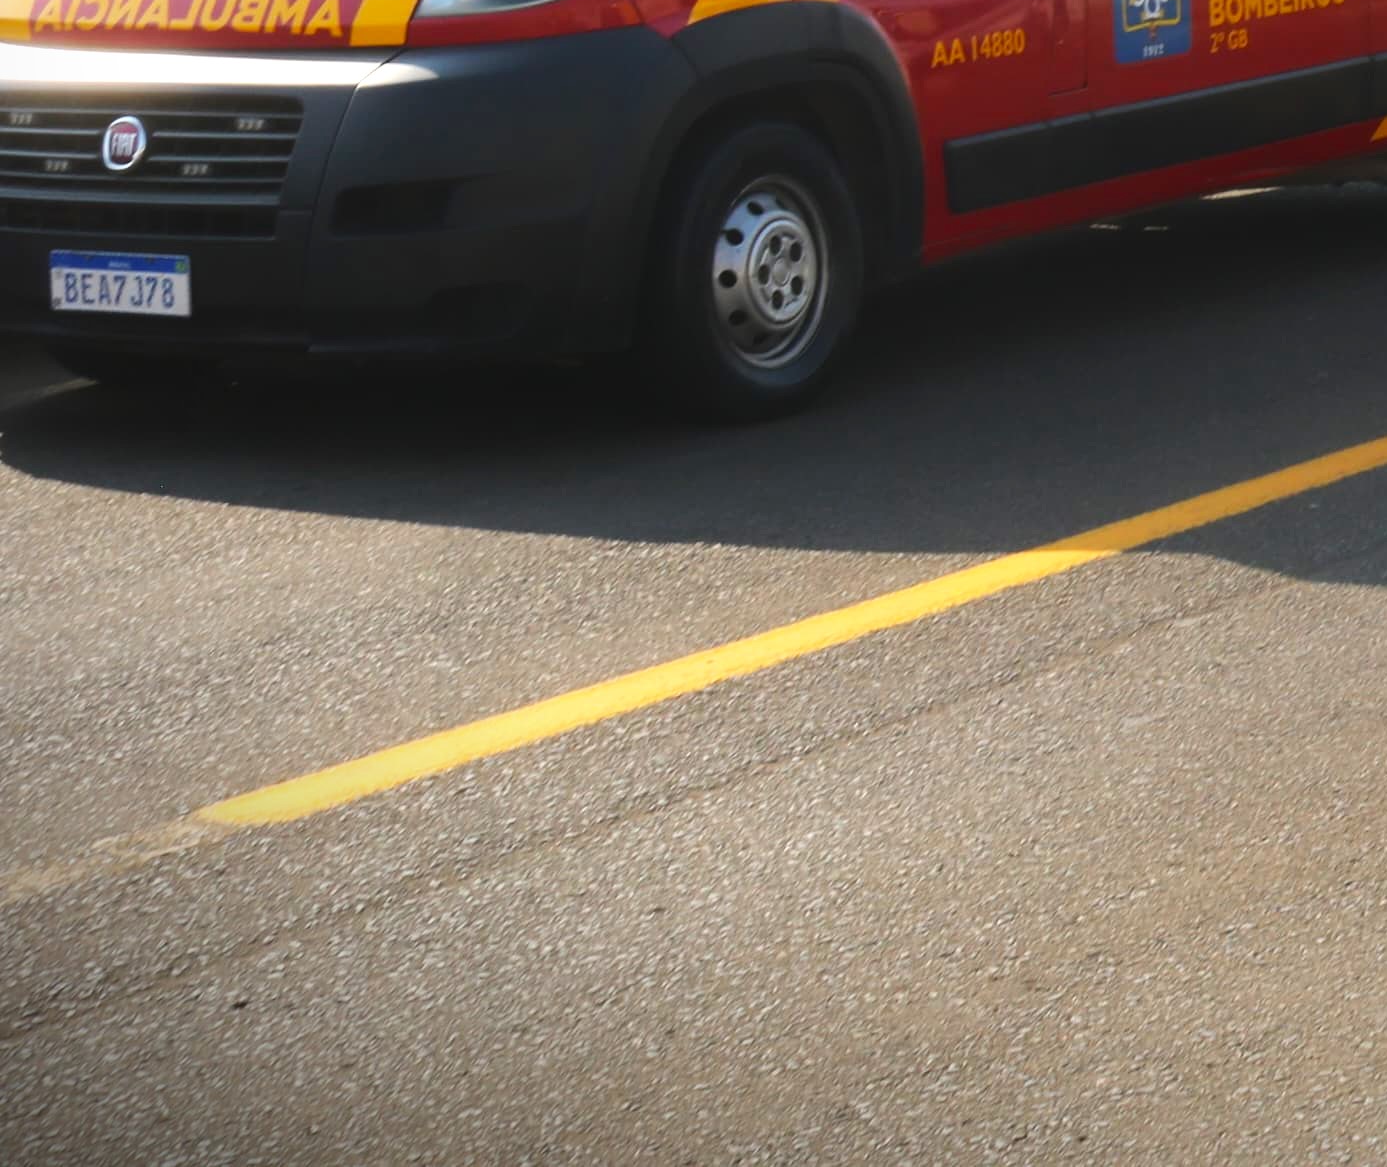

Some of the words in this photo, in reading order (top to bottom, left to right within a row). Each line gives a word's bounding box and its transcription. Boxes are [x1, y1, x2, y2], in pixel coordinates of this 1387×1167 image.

[930, 37, 965, 69] AA
[1228, 29, 1248, 50] GB
[111, 132, 137, 157] FIAT
[64, 272, 175, 309] BEA7J78
